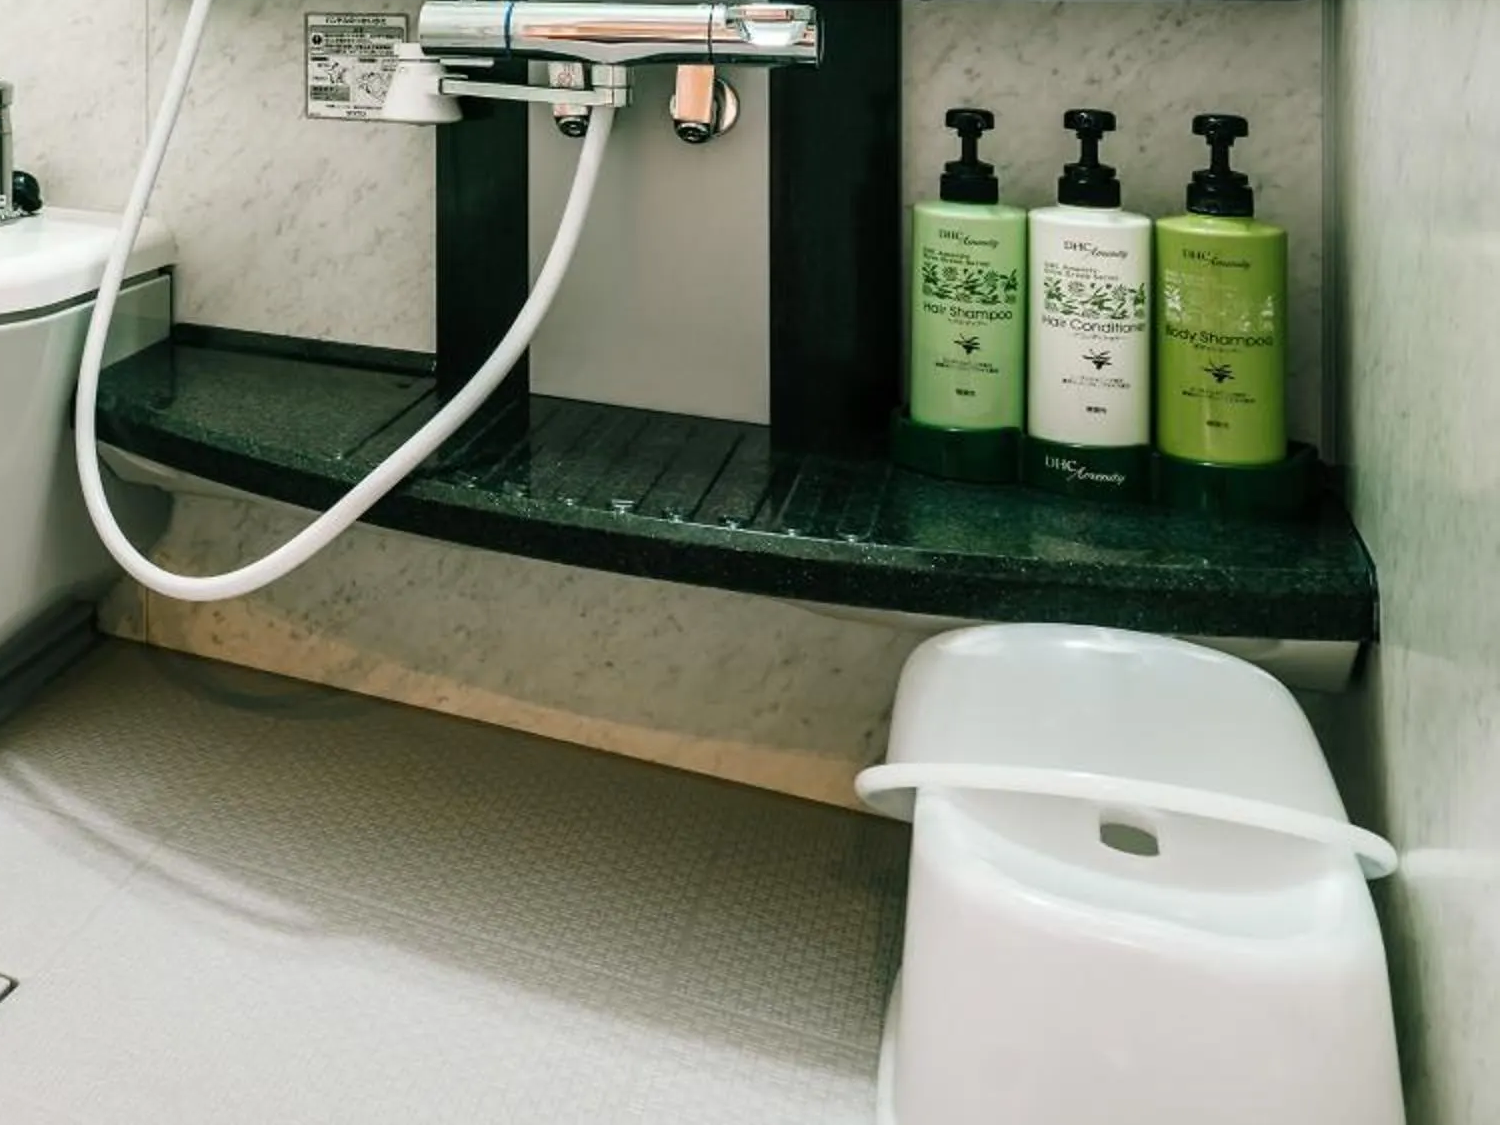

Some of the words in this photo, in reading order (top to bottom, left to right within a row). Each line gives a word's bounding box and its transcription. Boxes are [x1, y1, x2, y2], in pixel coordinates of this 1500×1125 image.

[1064, 241, 1092, 251] DHC
[923, 303, 947, 314] Hair
[949, 306, 1013, 322] Shampoo
[1041, 315, 1067, 328] Hair
[1165, 324, 1197, 344] Body
[1199, 331, 1274, 348] Shampoo
[1045, 455, 1077, 472] DHC
